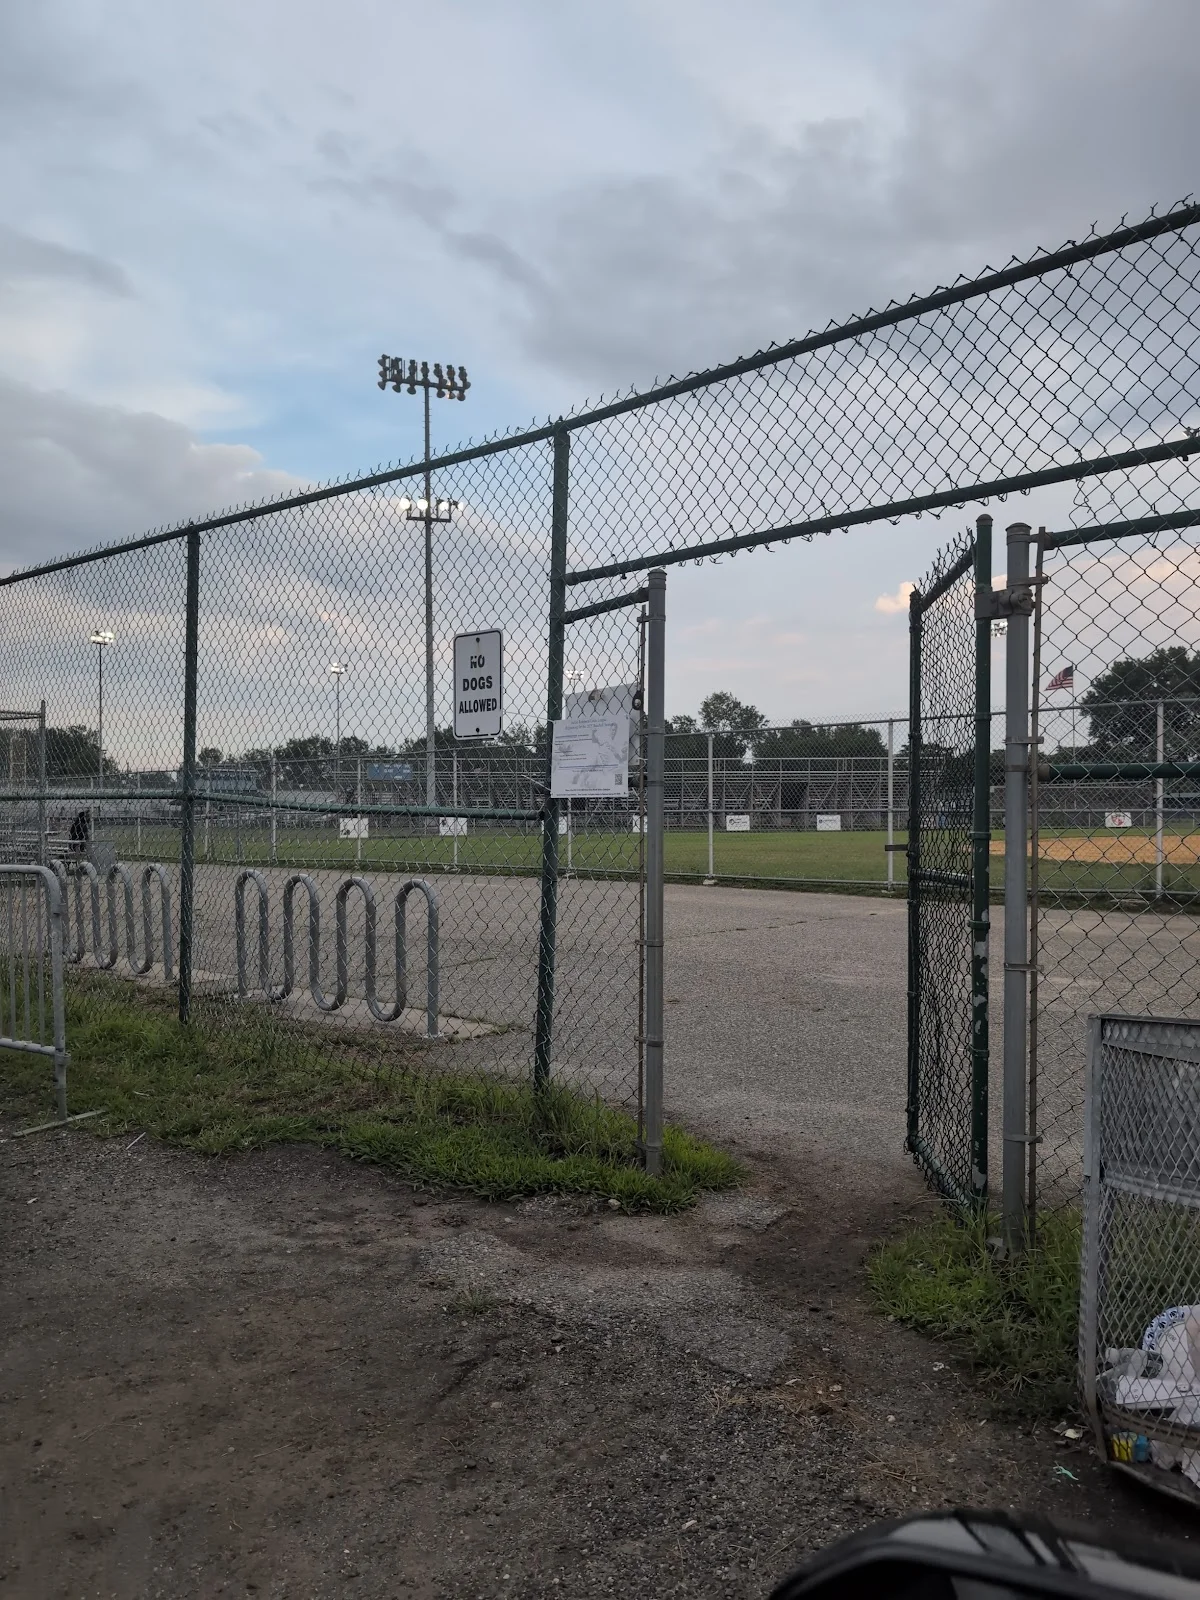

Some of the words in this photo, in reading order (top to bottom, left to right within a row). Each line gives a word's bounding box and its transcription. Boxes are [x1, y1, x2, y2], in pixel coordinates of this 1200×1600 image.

[470, 654, 485, 669] NO
[462, 675, 493, 692] DOGS
[458, 698, 497, 714] ALLOWED
